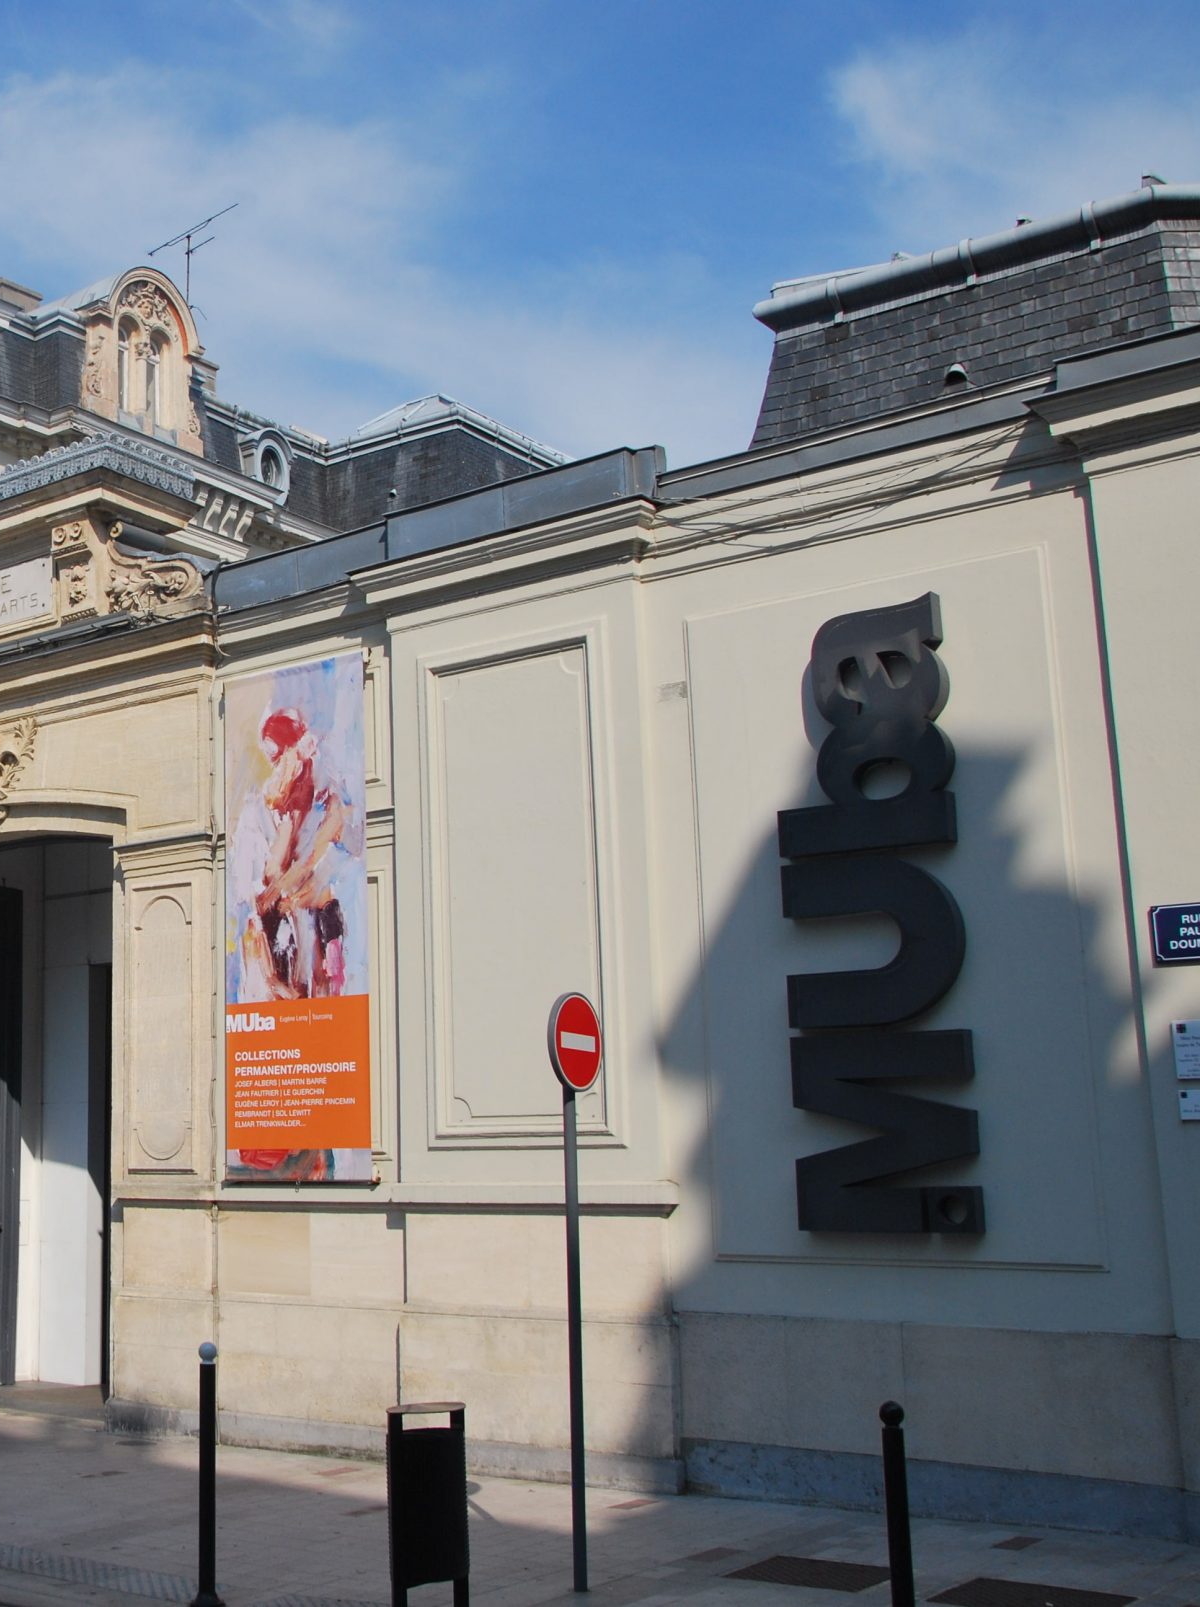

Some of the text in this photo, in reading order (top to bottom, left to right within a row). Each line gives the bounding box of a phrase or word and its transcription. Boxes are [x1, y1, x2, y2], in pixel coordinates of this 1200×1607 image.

[0, 592, 38, 616] ARTS
[1181, 913, 1200, 924] RU
[226, 1012, 276, 1033] MUba
[234, 1049, 300, 1062] COLLECTIONS
[234, 1062, 356, 1076] PERMANENT/PROVISOIRE
[292, 1088, 324, 1096] GUERCHIN
[260, 1099, 279, 1107] LEROY
[284, 1098, 323, 1107] JEAN-PIERRE
[234, 1108, 311, 1118] REMBRANDT SOL LEWITT
[234, 1120, 255, 1128] ELMAR
